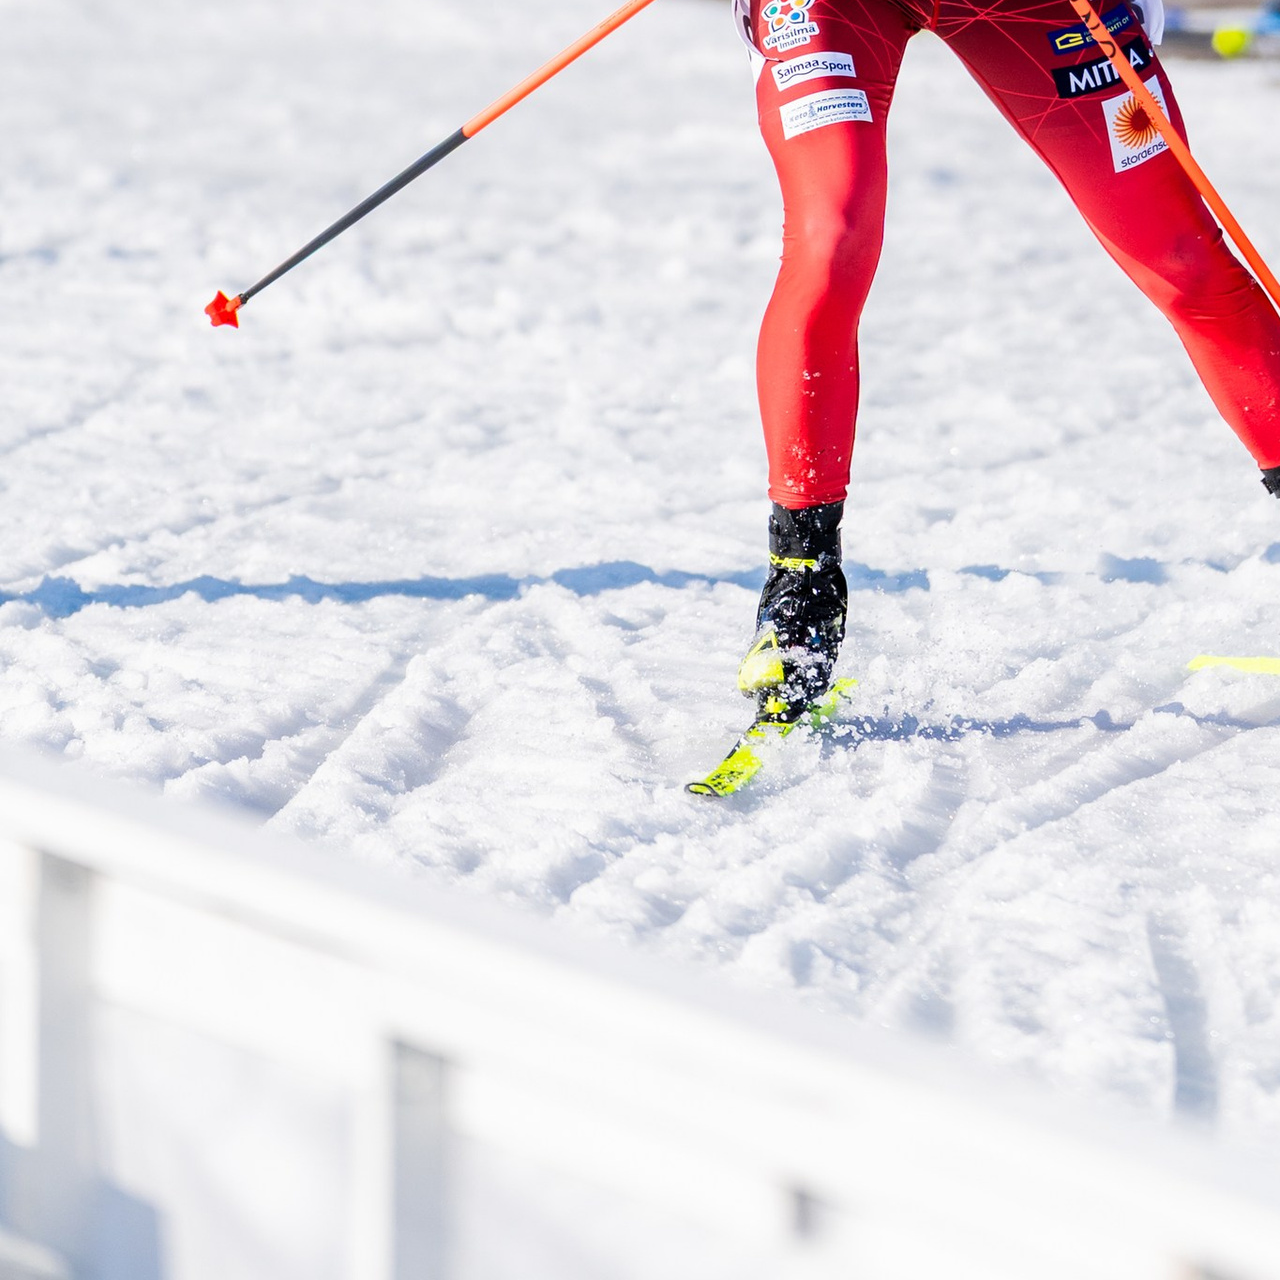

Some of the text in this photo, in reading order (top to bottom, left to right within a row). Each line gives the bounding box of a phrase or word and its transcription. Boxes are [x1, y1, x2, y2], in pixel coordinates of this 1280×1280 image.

[780, 35, 808, 50] Imatra
[777, 59, 853, 80] Saimaa Sport
[816, 100, 864, 113] Harvesters
